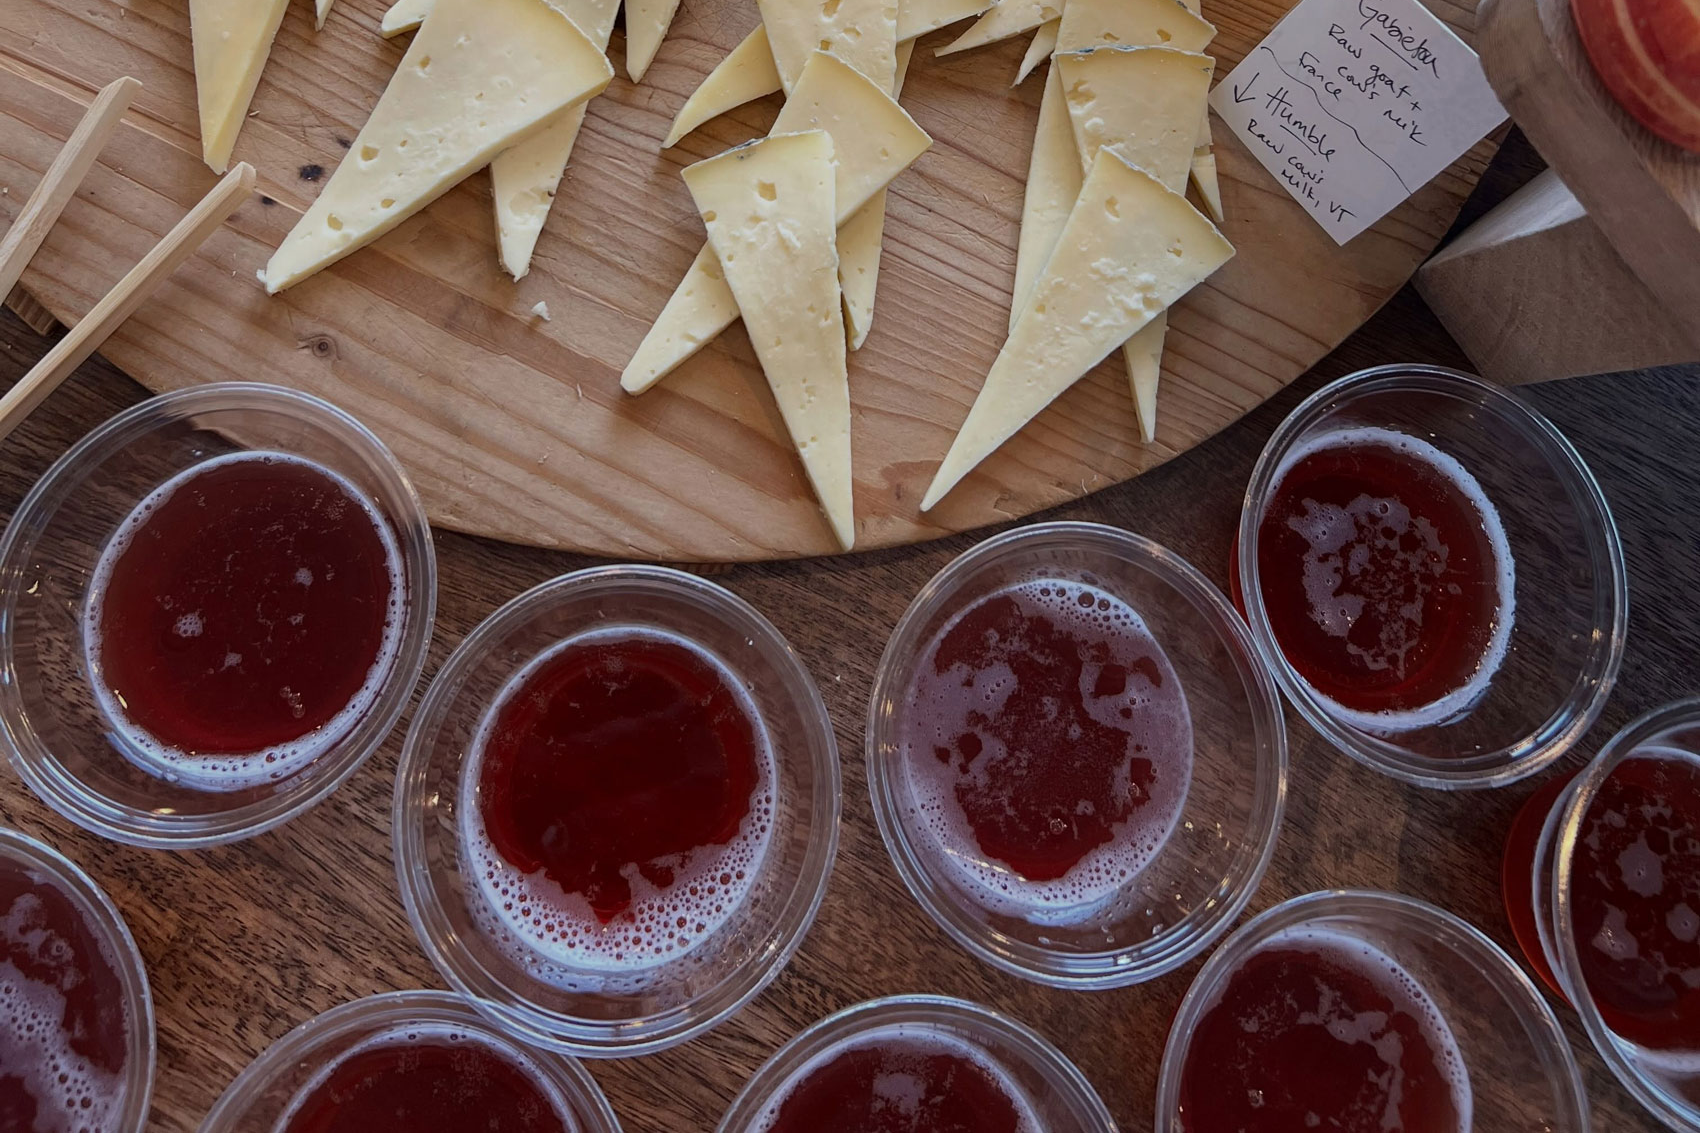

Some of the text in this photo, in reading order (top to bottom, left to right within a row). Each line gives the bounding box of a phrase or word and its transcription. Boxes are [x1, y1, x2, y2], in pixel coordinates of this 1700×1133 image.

[1299, 51, 1342, 101] France
[1328, 23, 1363, 59] Raw
[1368, 64, 1411, 99] goat
[1248, 119, 1284, 154] Raw
[1266, 87, 1336, 162] Humble
[1329, 201, 1357, 222] VT
